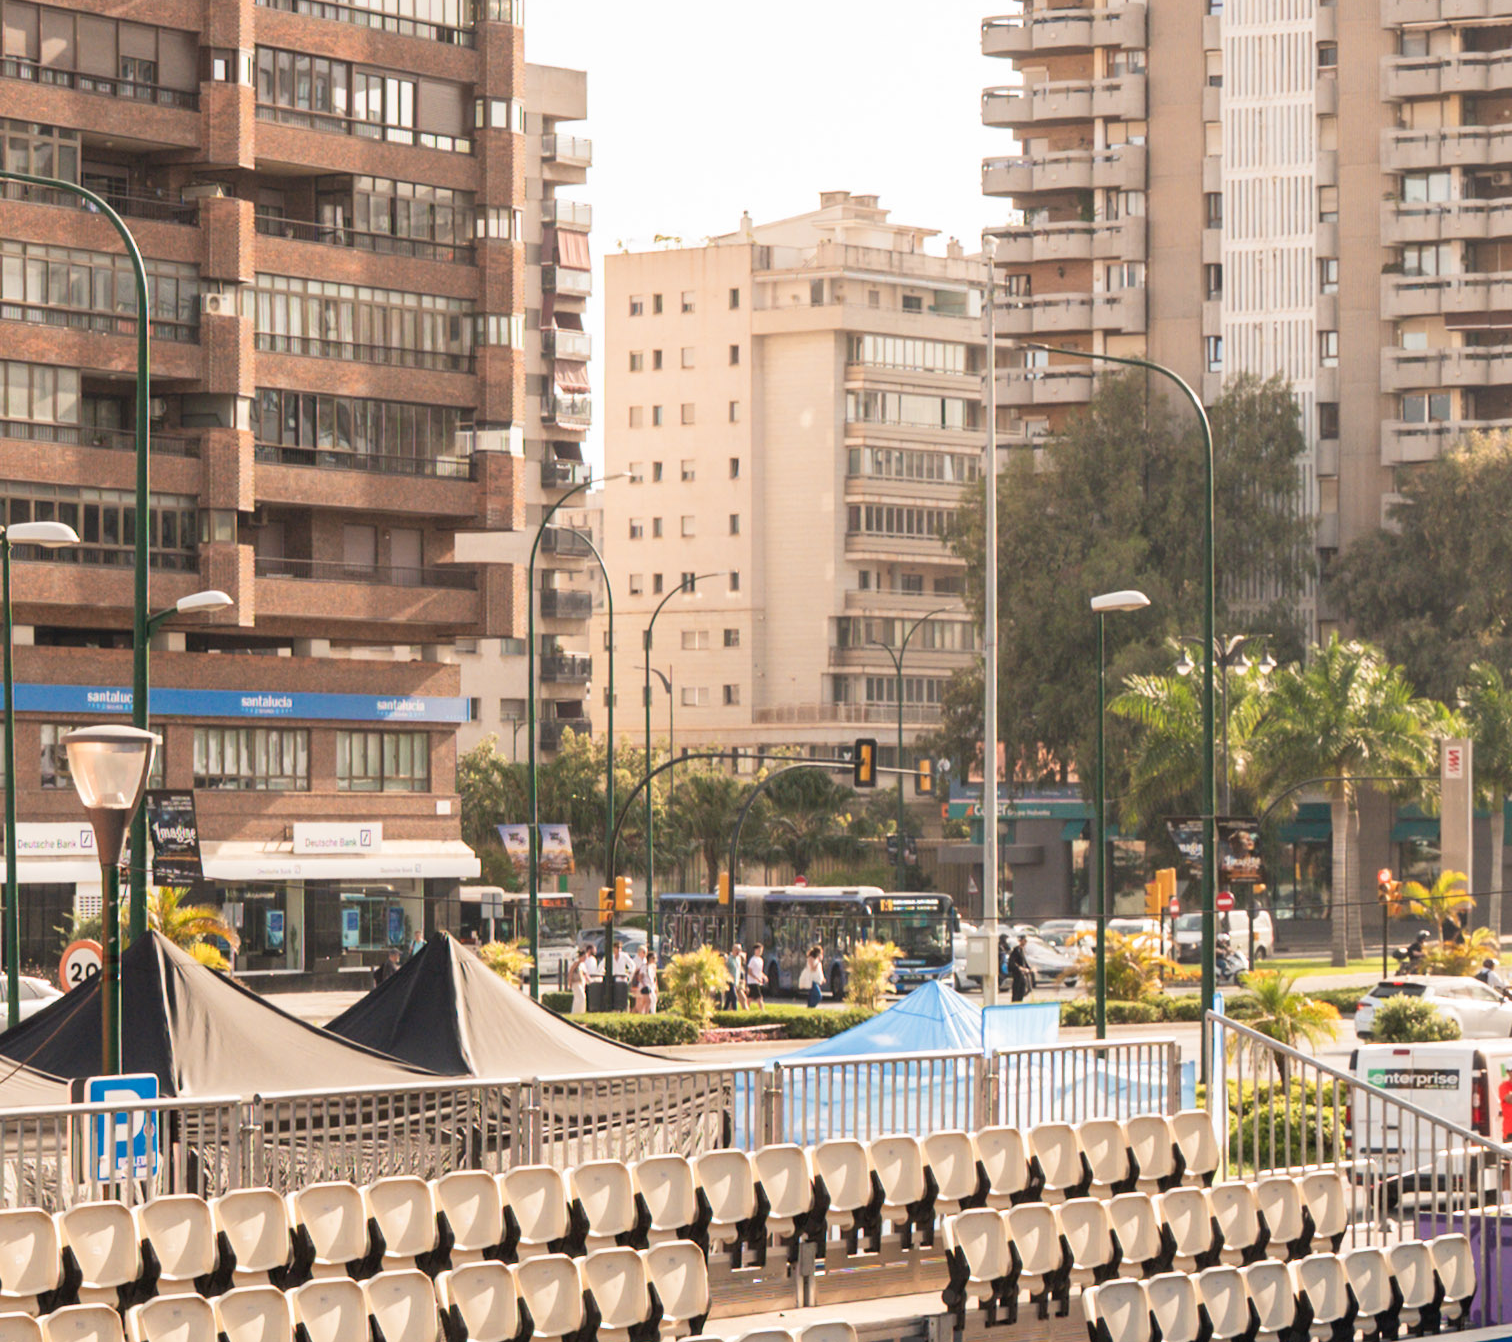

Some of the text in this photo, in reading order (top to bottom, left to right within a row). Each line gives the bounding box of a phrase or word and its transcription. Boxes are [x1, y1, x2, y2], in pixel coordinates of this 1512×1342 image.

[87, 690, 134, 703] santaluc
[17, 839, 76, 849] Deutsche Bank
[305, 837, 357, 848] Deutsche Bank
[71, 963, 98, 982] 20
[1370, 1070, 1459, 1088] enterprise
